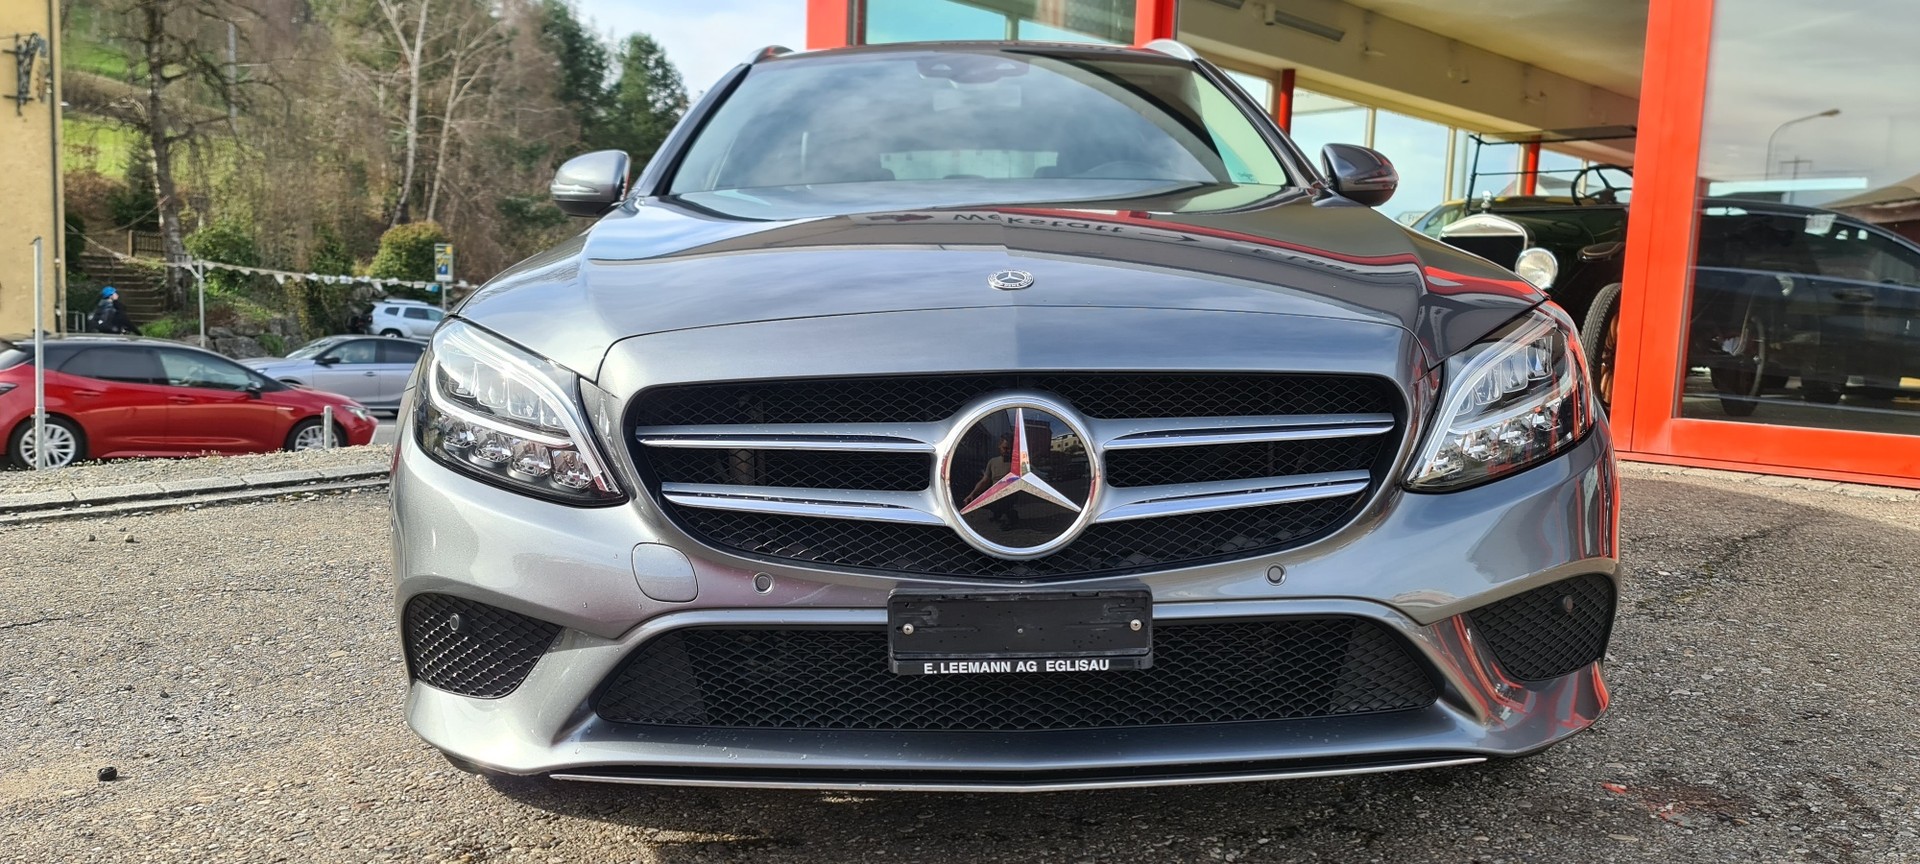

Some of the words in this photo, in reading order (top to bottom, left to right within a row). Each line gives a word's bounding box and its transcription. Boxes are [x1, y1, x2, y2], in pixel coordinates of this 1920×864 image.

[924, 663, 937, 674] E.
[940, 662, 1011, 674] LEEMANN
[1015, 660, 1038, 673] AG
[1046, 660, 1110, 672] EGLISAU
